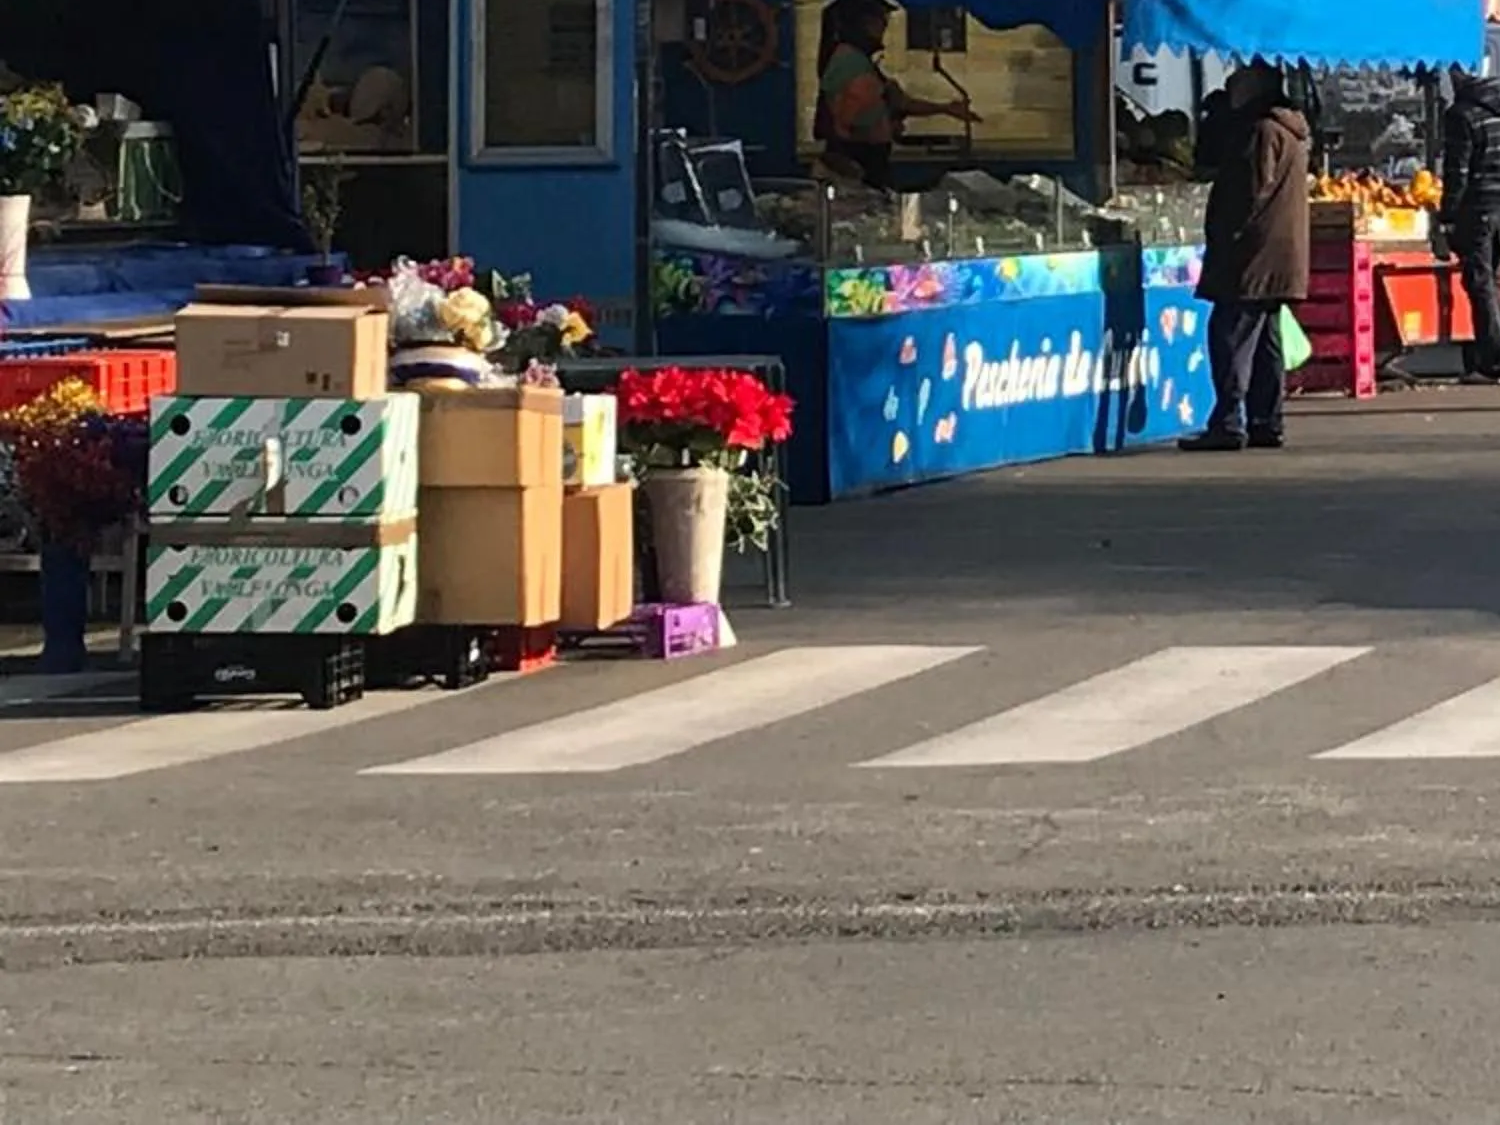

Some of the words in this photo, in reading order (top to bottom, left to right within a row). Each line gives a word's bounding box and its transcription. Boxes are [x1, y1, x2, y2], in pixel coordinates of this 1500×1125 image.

[962, 337, 1061, 411] Pescheria
[1061, 329, 1093, 396] da
[191, 430, 346, 447] FLORICLTURA
